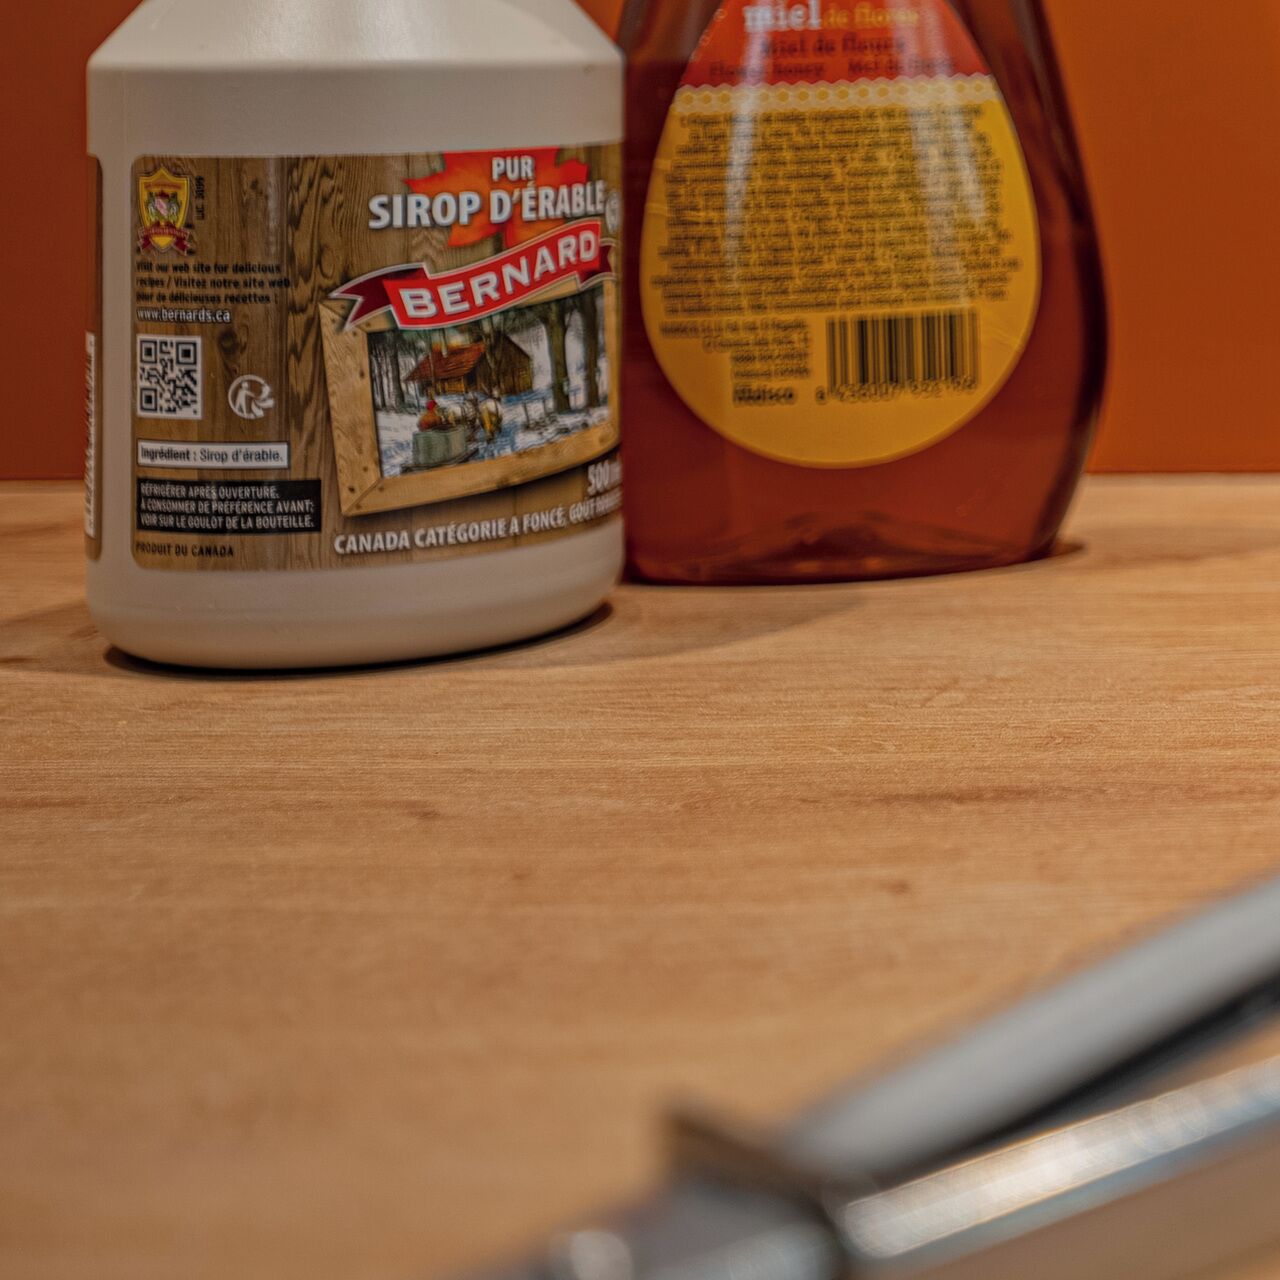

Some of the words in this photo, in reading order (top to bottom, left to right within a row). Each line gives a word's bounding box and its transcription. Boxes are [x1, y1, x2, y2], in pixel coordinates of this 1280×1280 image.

[491, 156, 534, 182] PUR
[368, 191, 481, 229] SIROP
[489, 180, 607, 224] D'ÉRABLE
[171, 262, 190, 273] web
[193, 262, 211, 273] site
[214, 262, 228, 273] for
[232, 262, 282, 274] delicious
[398, 230, 599, 319] BERNARD
[174, 276, 207, 289] Visitez
[210, 276, 240, 289] notre
[243, 277, 264, 289] site
[268, 276, 291, 289] web
[224, 292, 271, 304] recettes
[137, 307, 231, 323] www.bernards.ca
[141, 445, 191, 462] Ingrédient
[200, 447, 228, 463] Sirop
[231, 447, 283, 463] d'érable.
[147, 499, 196, 513] CONSOMMER
[198, 501, 210, 513] DE
[212, 499, 273, 514] PRÉFÉRENCE
[175, 516, 187, 527] LE
[188, 516, 223, 529] GOULOT
[225, 516, 238, 529] DE
[240, 516, 252, 529] LA
[333, 530, 410, 556] CANADA
[414, 515, 506, 548] CATÉGORIE
[508, 515, 520, 535] A
[136, 542, 171, 555] PRODUIT
[175, 544, 188, 556] DU
[191, 545, 234, 557] CANADA
